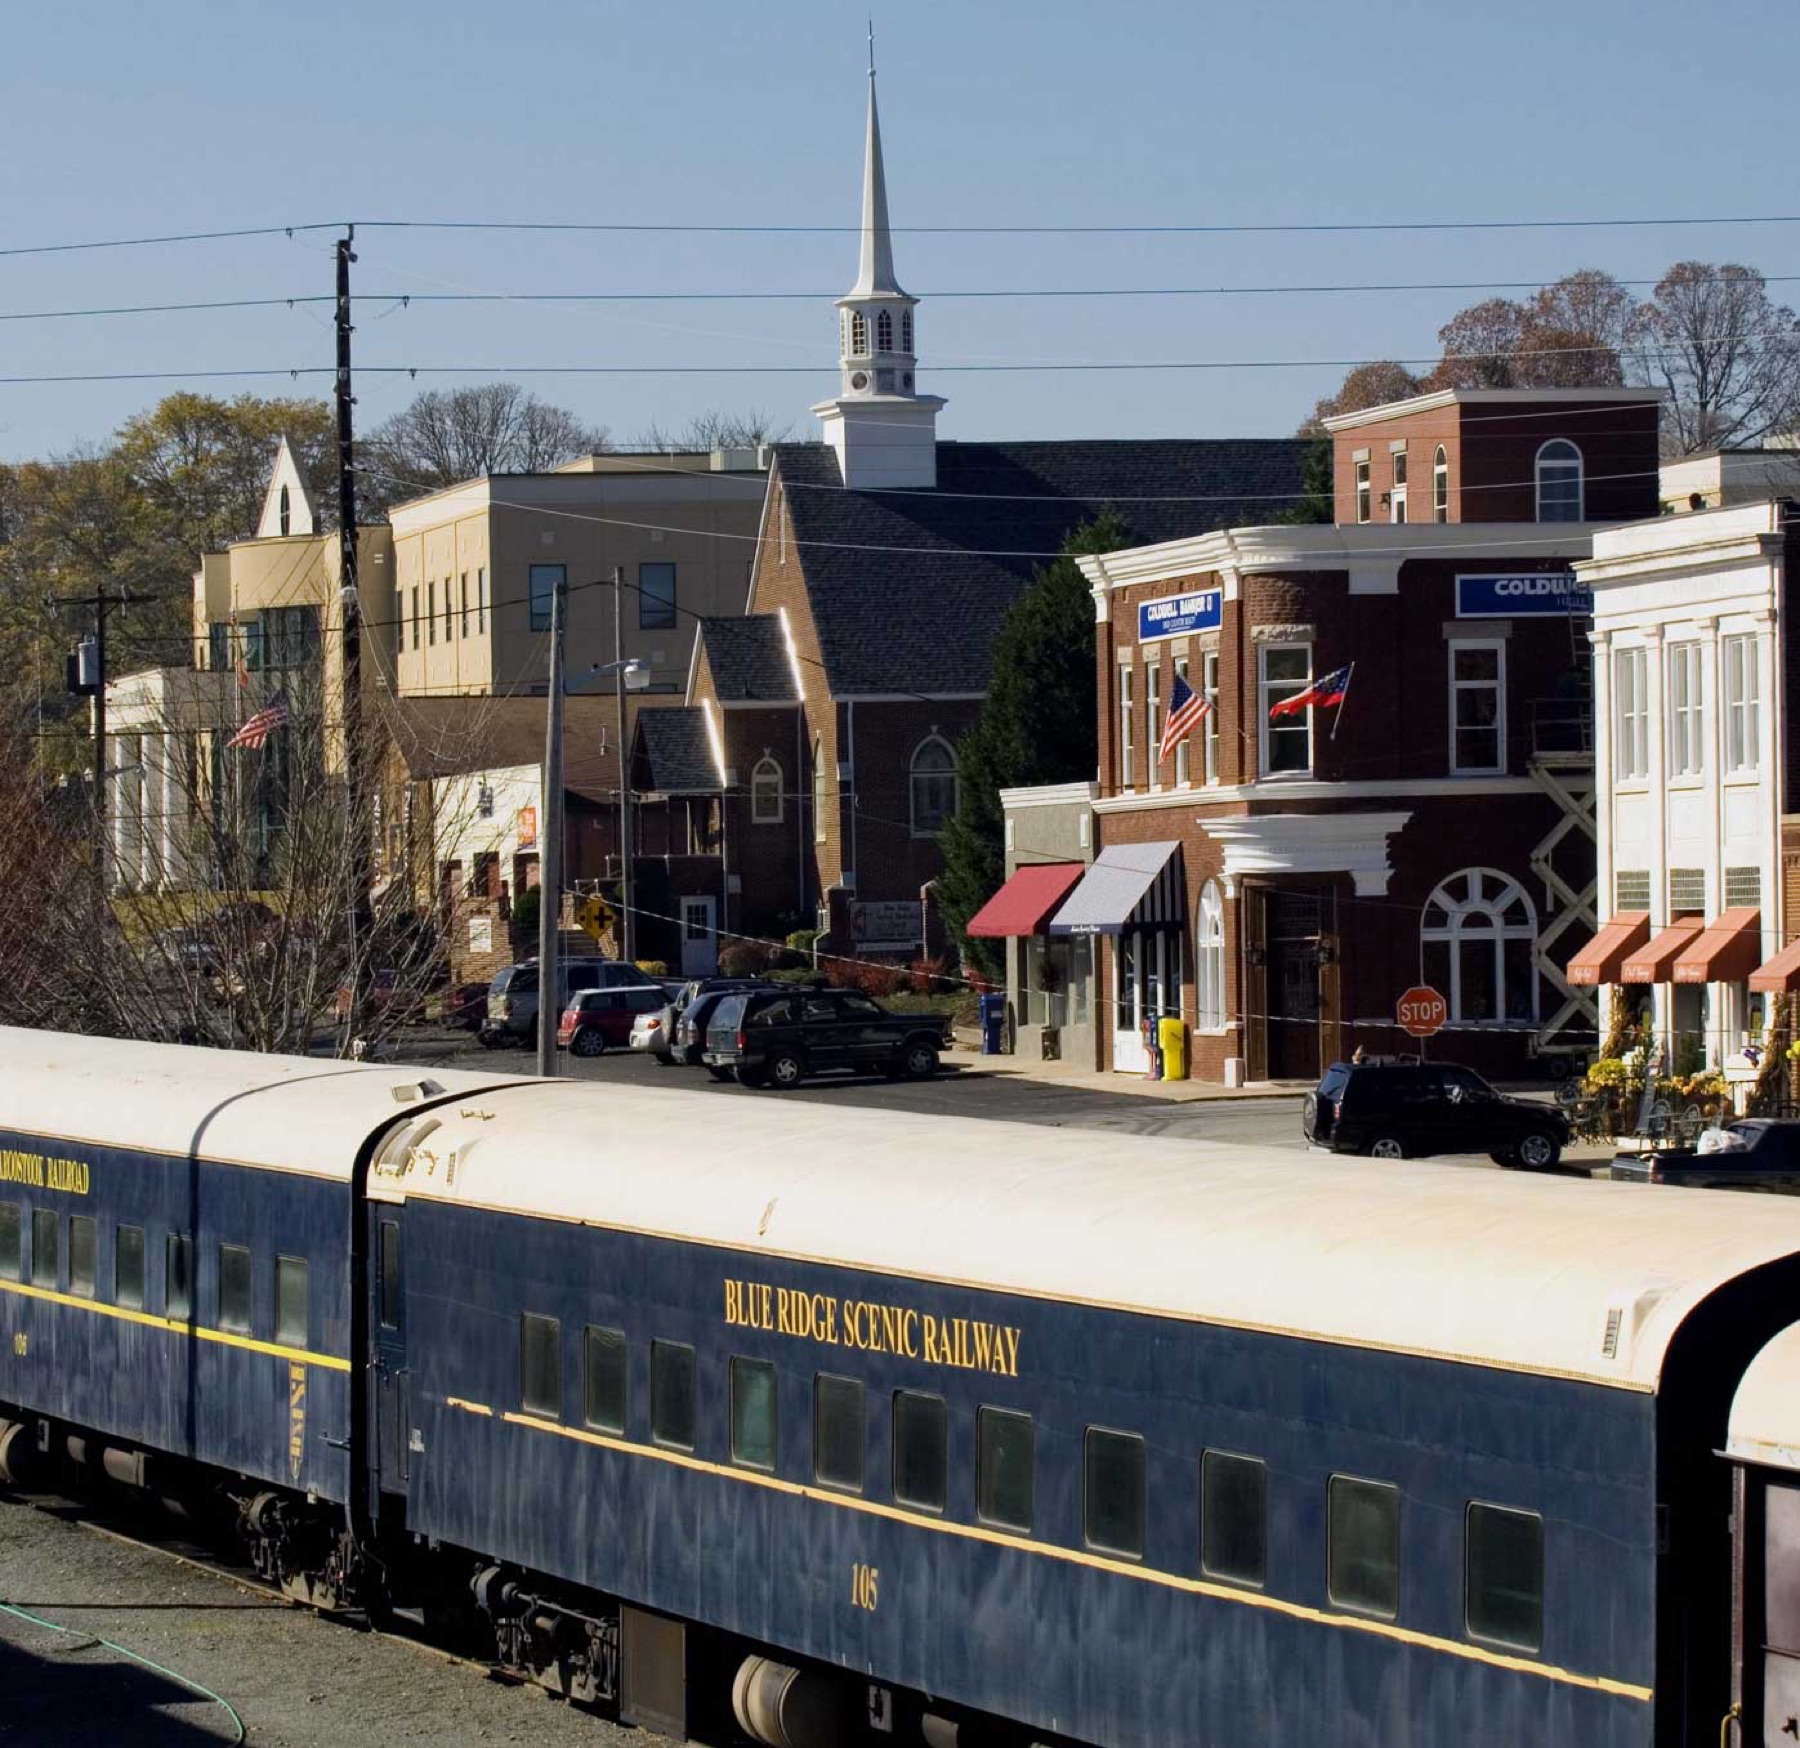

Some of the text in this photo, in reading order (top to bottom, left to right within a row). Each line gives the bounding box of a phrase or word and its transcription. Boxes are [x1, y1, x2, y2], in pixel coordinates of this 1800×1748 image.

[1401, 1002, 1442, 1022] STOP
[46, 1156, 90, 1195] RAILROAD
[724, 1279, 1021, 1377] BLUE RIDGE SCENIC RAILWAY
[851, 1562, 879, 1610] 105
